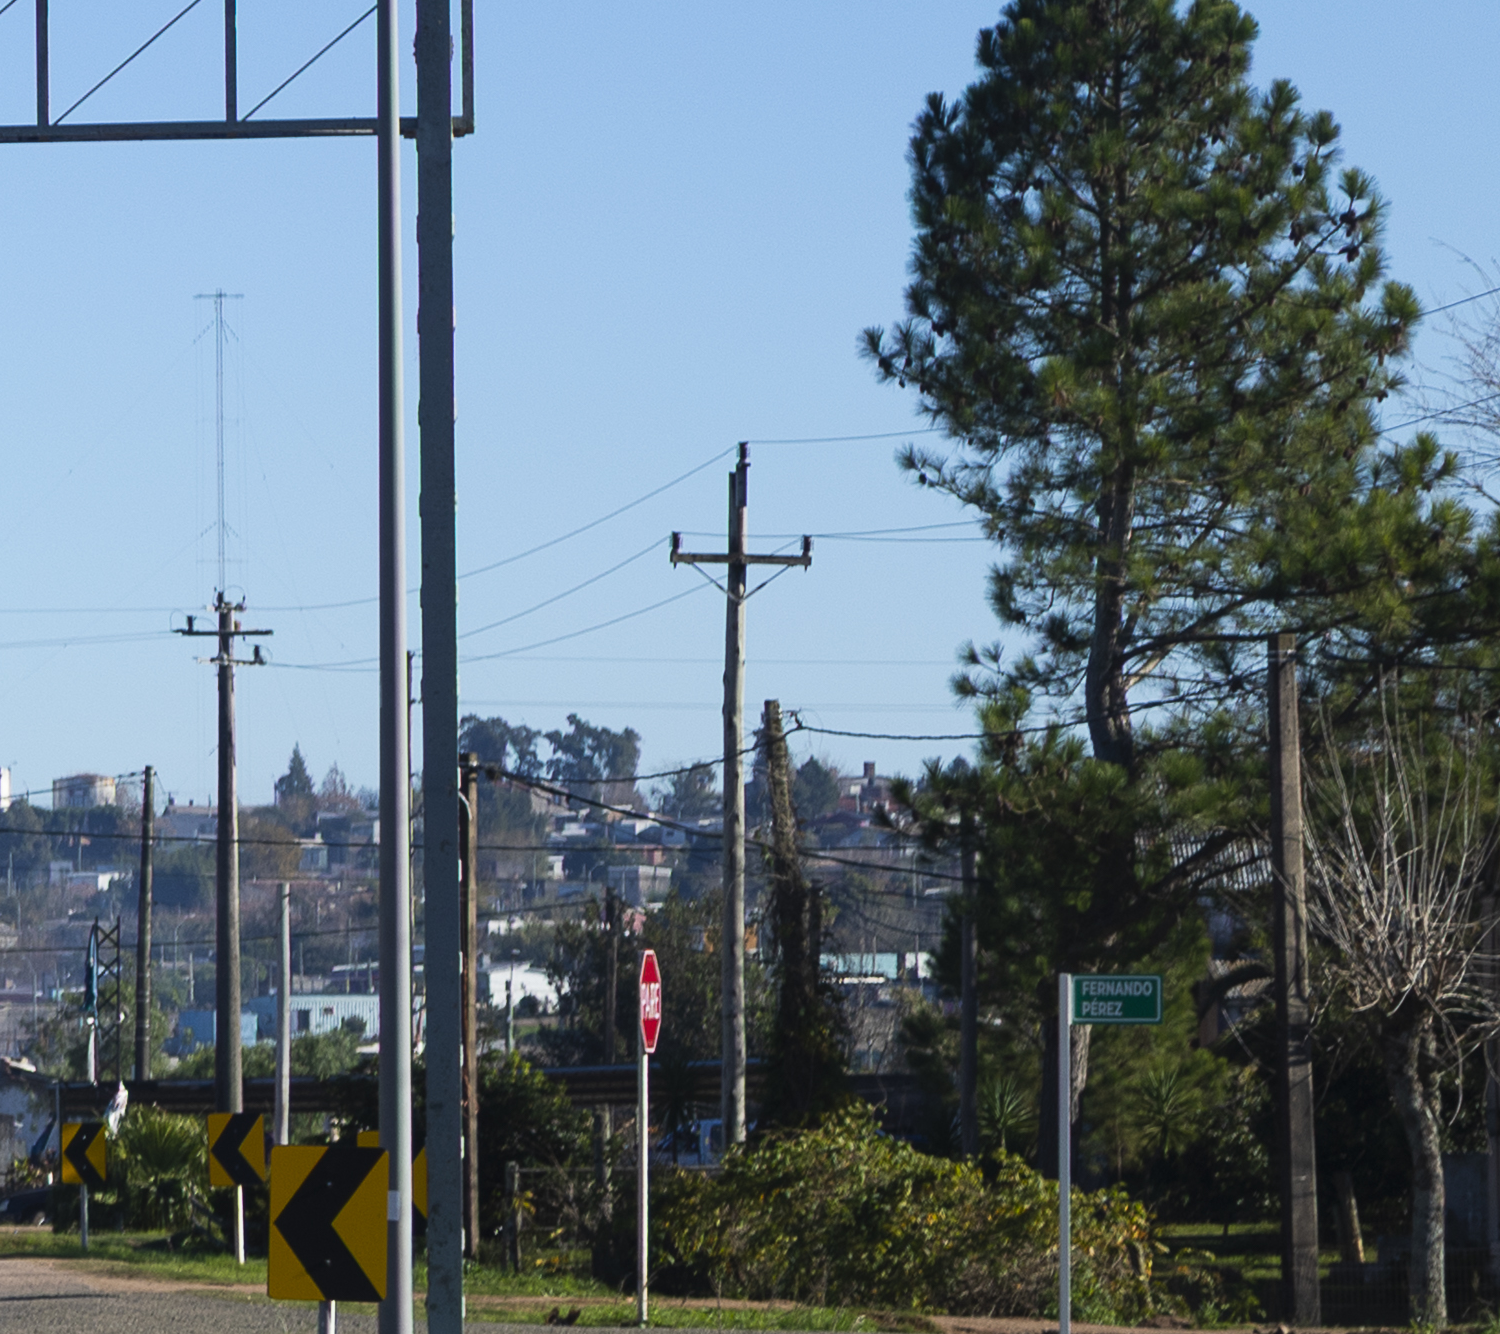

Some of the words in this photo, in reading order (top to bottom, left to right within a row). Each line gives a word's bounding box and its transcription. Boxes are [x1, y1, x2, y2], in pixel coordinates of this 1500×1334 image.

[1082, 980, 1153, 997] FERNANDO
[641, 982, 660, 1020] PARE
[1082, 997, 1123, 1016] PÉREZ
